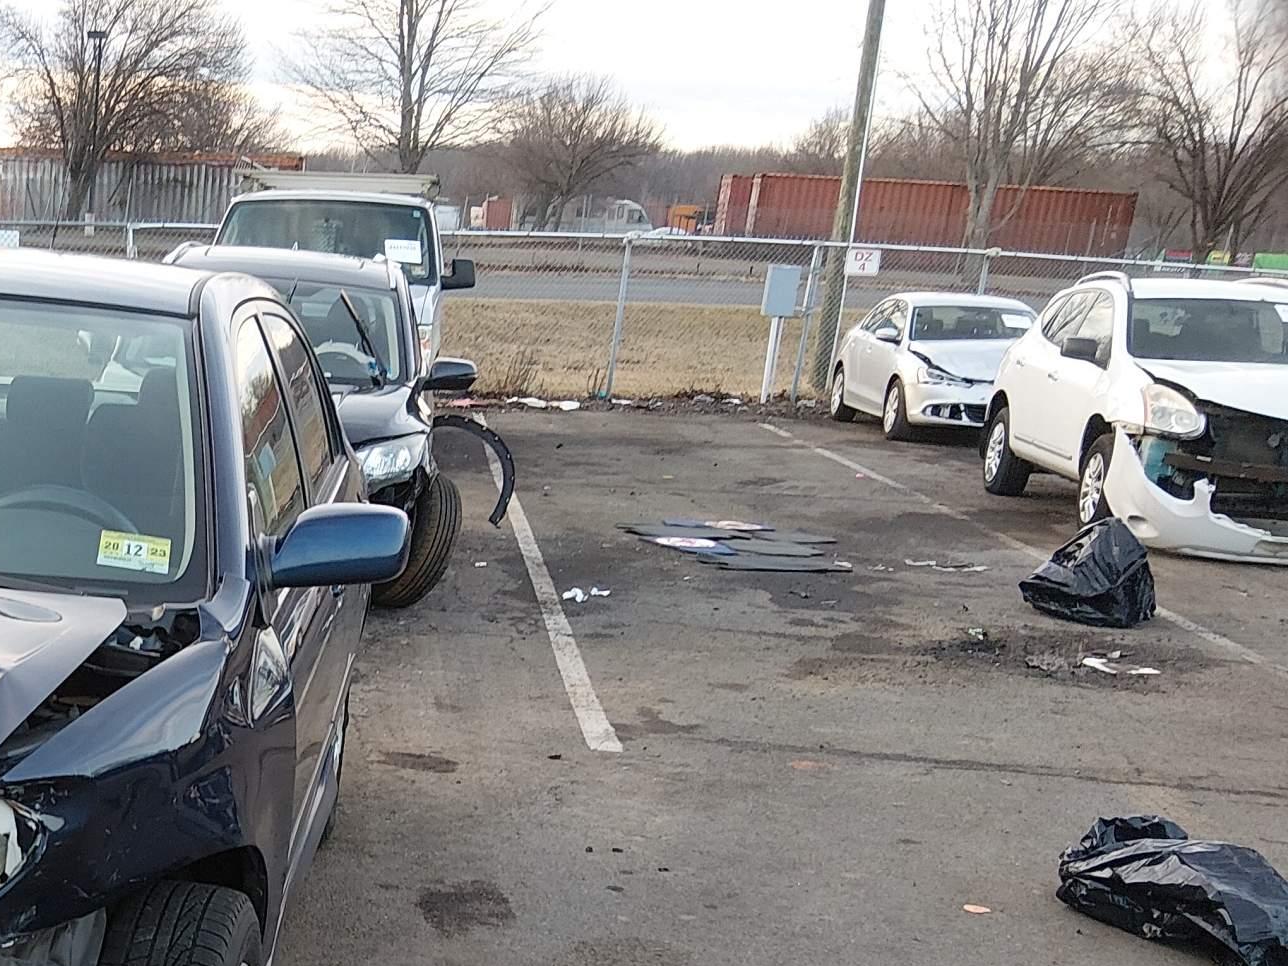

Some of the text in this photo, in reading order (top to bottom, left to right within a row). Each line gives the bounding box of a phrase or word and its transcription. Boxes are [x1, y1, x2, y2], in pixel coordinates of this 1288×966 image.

[855, 252, 873, 261] DZ
[858, 262, 866, 272] 4
[103, 540, 120, 551] 20
[125, 543, 143, 557] 12
